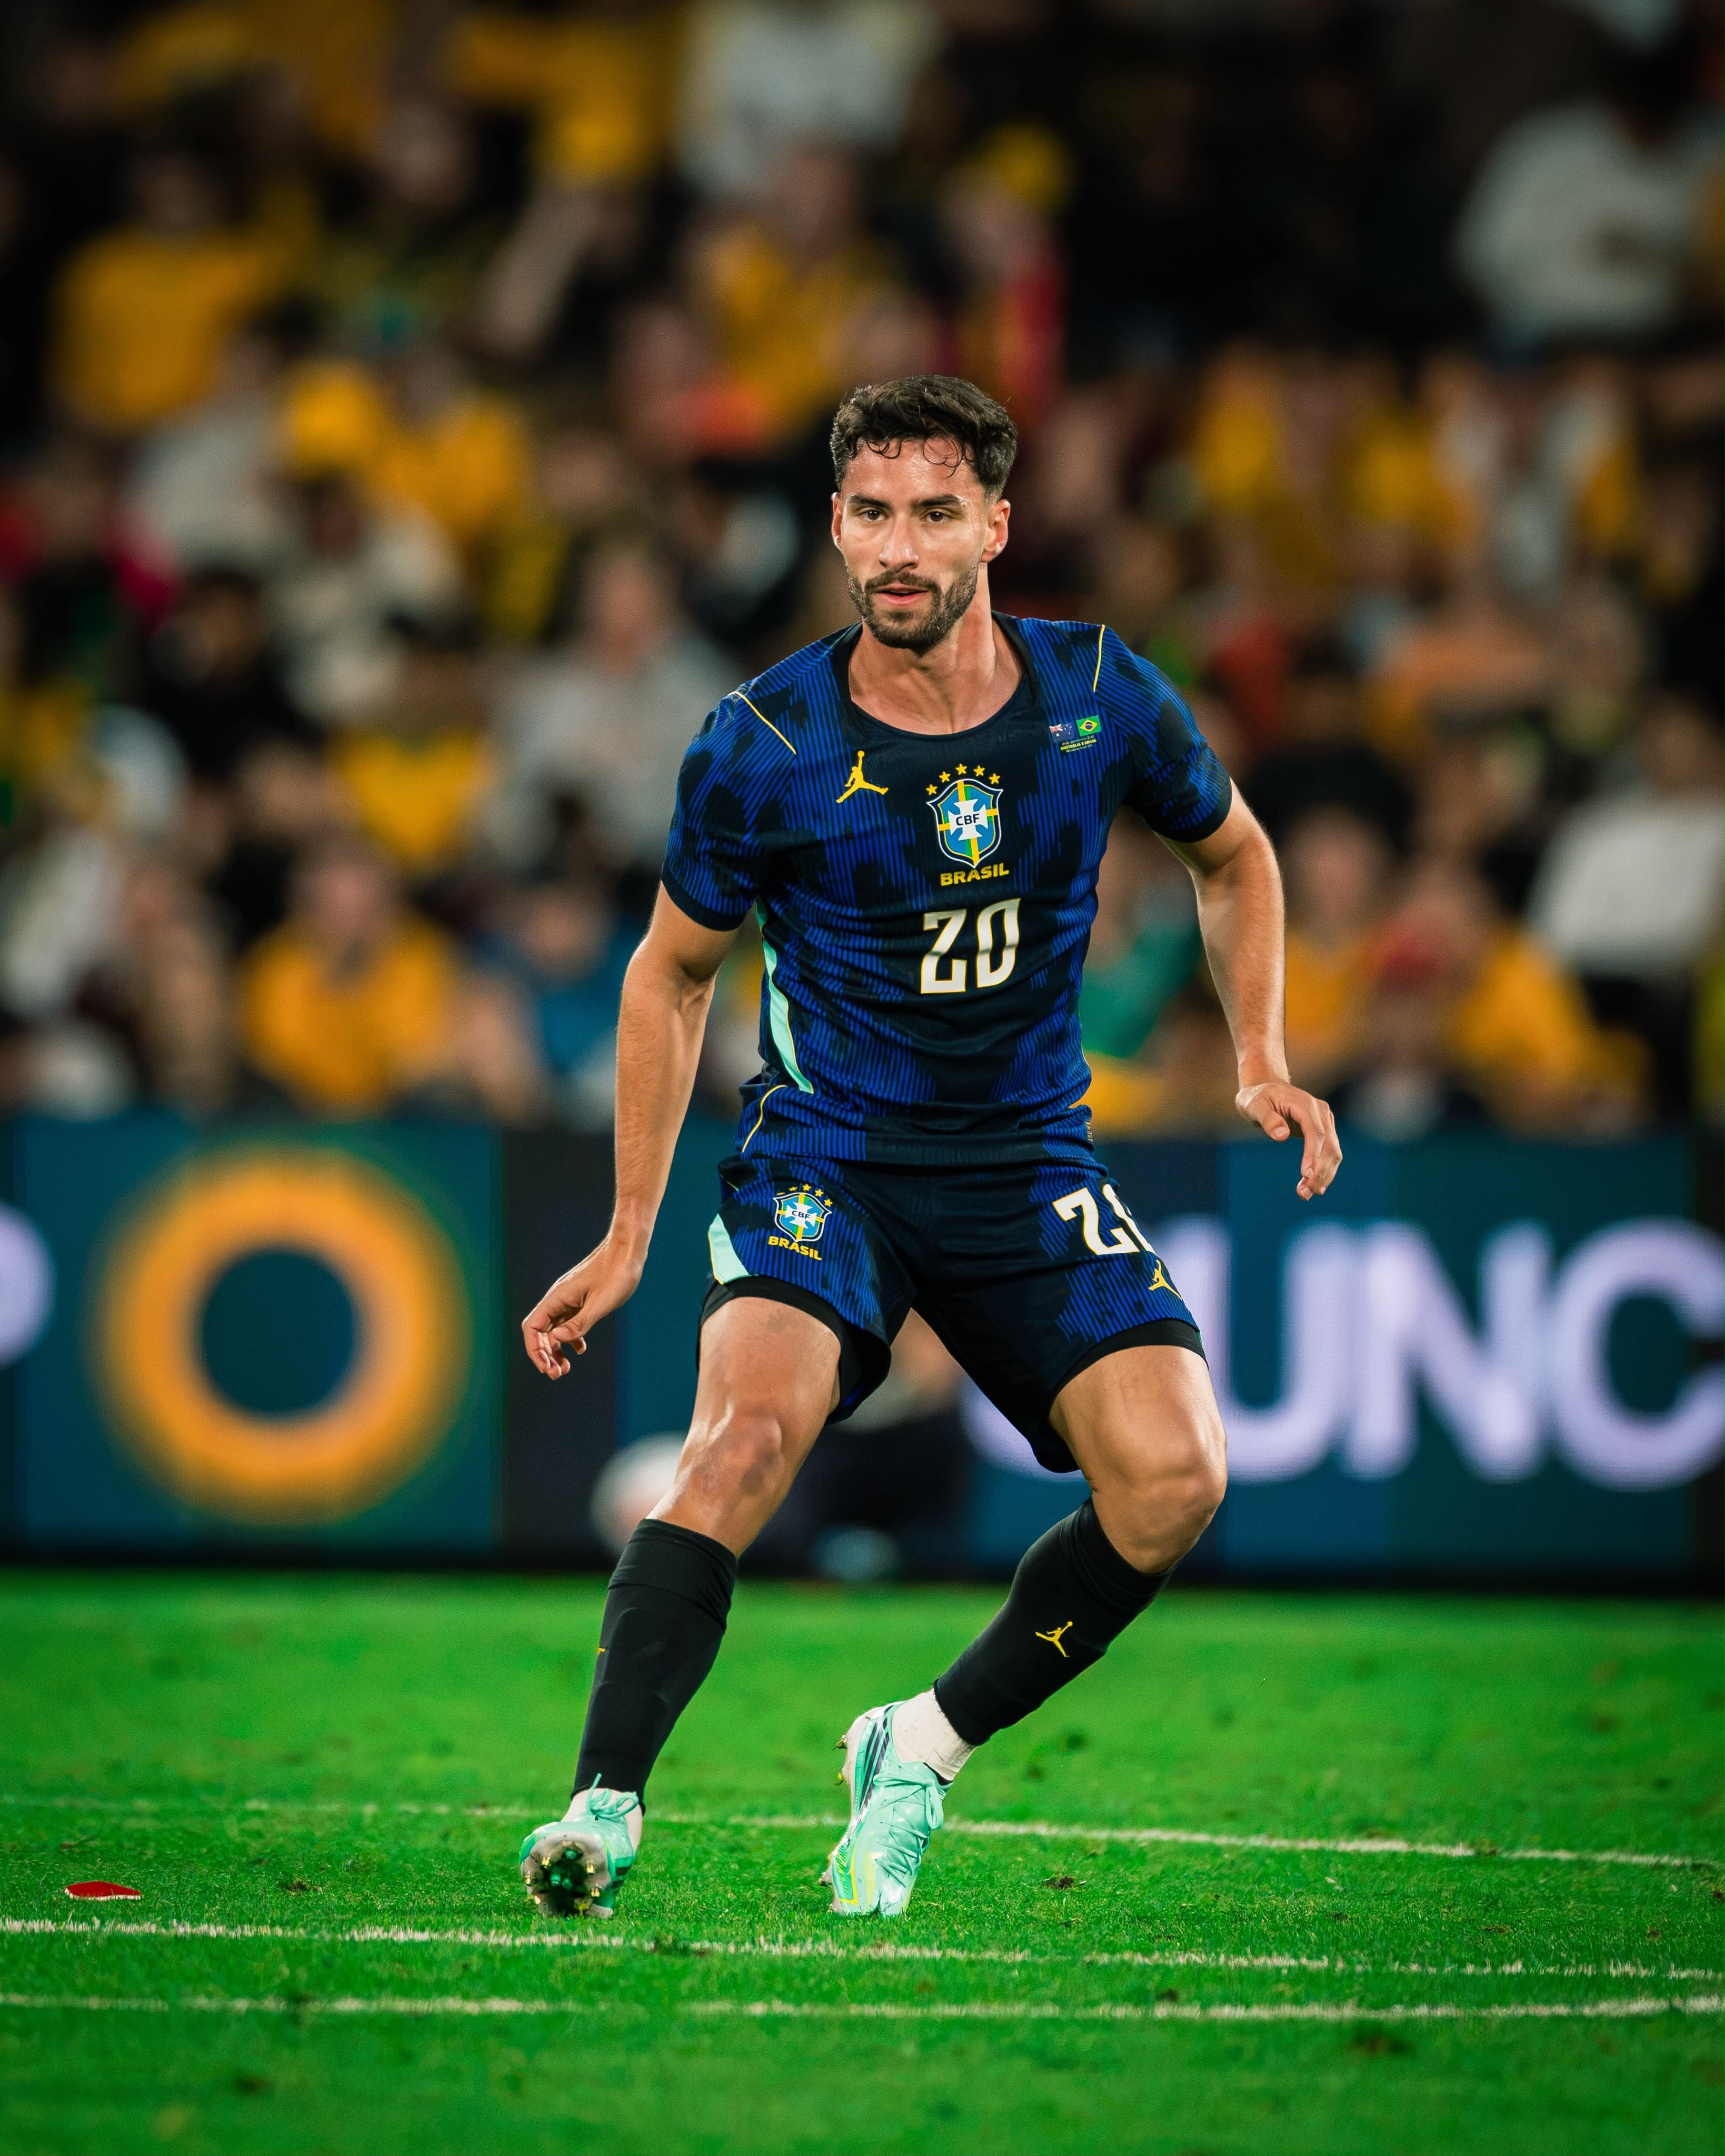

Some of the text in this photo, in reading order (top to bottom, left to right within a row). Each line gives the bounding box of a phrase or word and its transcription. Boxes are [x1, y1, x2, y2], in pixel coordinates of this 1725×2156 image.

[956, 813, 980, 826] CBF
[940, 863, 1009, 886] BRASIL
[921, 898, 1021, 994] 20
[792, 1210, 811, 1220] CBF
[768, 1236, 822, 1261] BRASIL
[964, 1219, 1725, 1487] UNC
